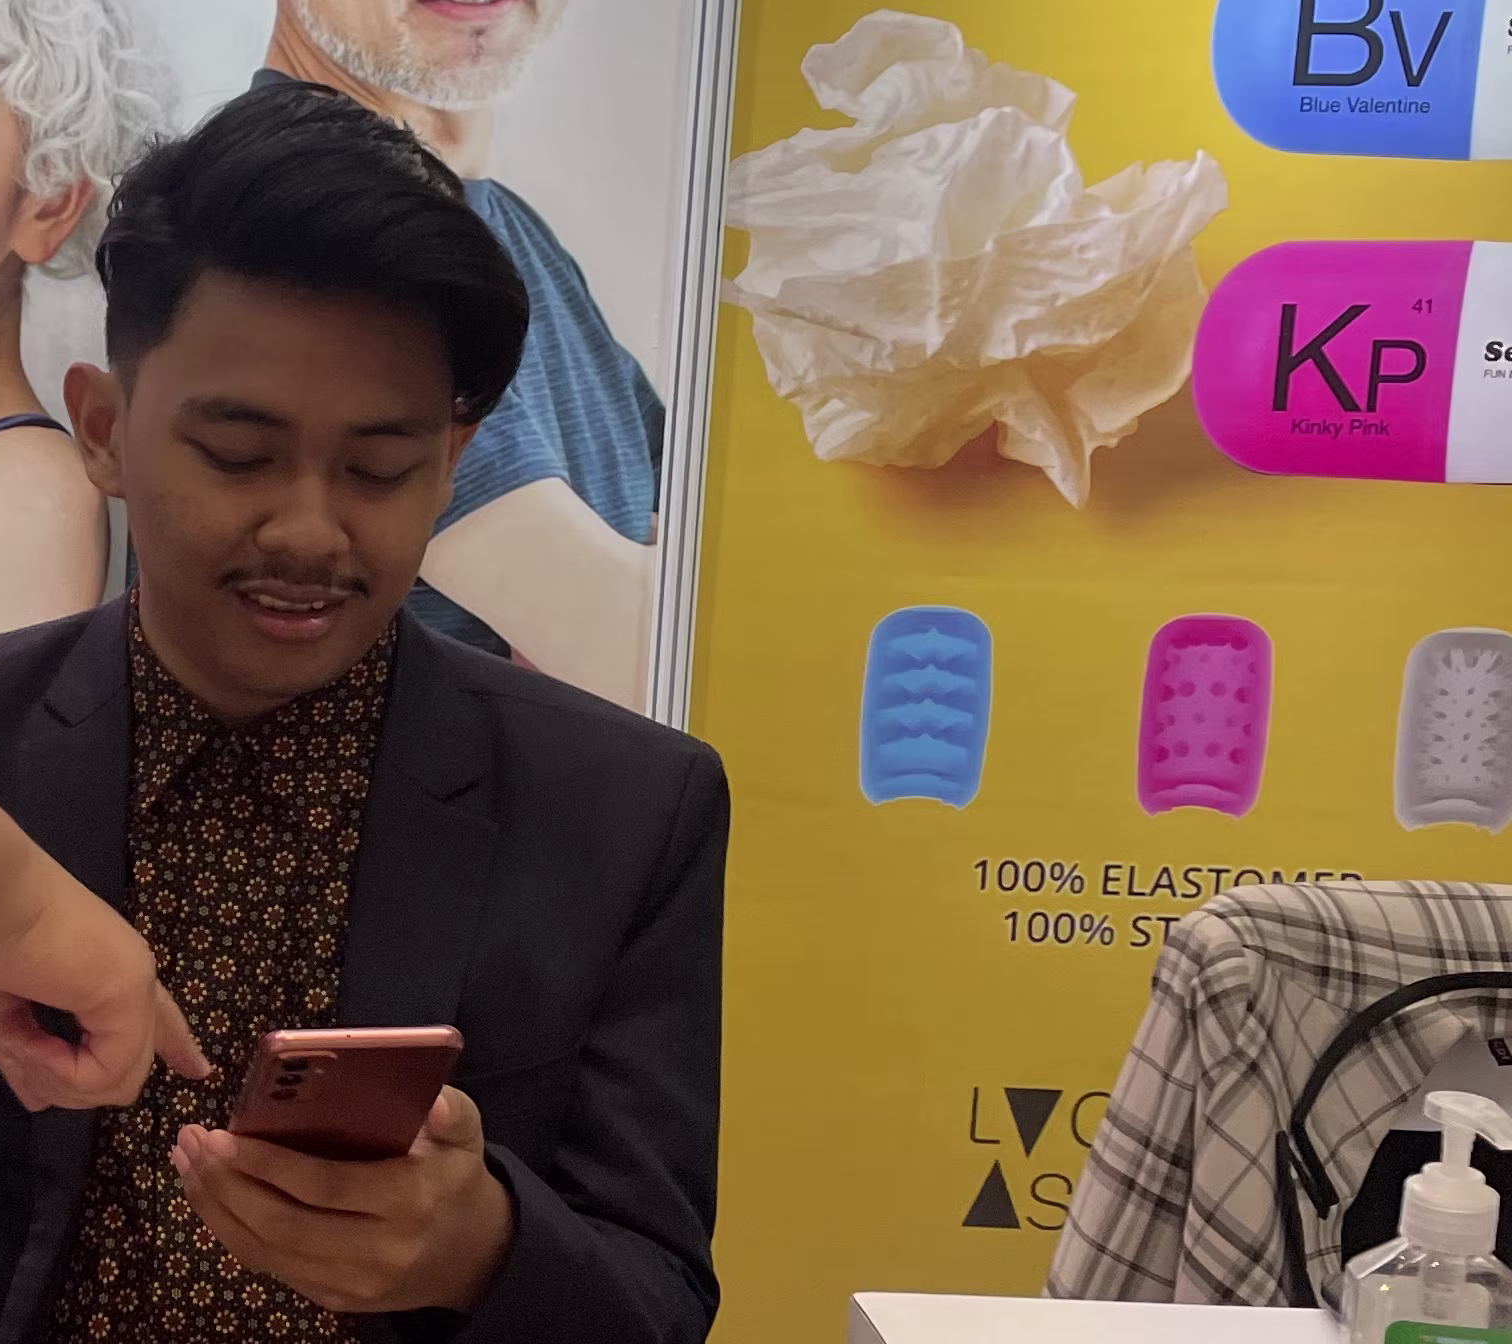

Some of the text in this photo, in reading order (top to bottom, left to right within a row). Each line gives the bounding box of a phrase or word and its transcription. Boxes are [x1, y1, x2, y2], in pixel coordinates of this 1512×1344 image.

[1298, 96, 1431, 115] Blue Valentine
[1411, 298, 1433, 315] 41
[1290, 418, 1391, 440] Kinky Pink
[974, 859, 1086, 895] 100%
[1004, 910, 1116, 947] 100%
